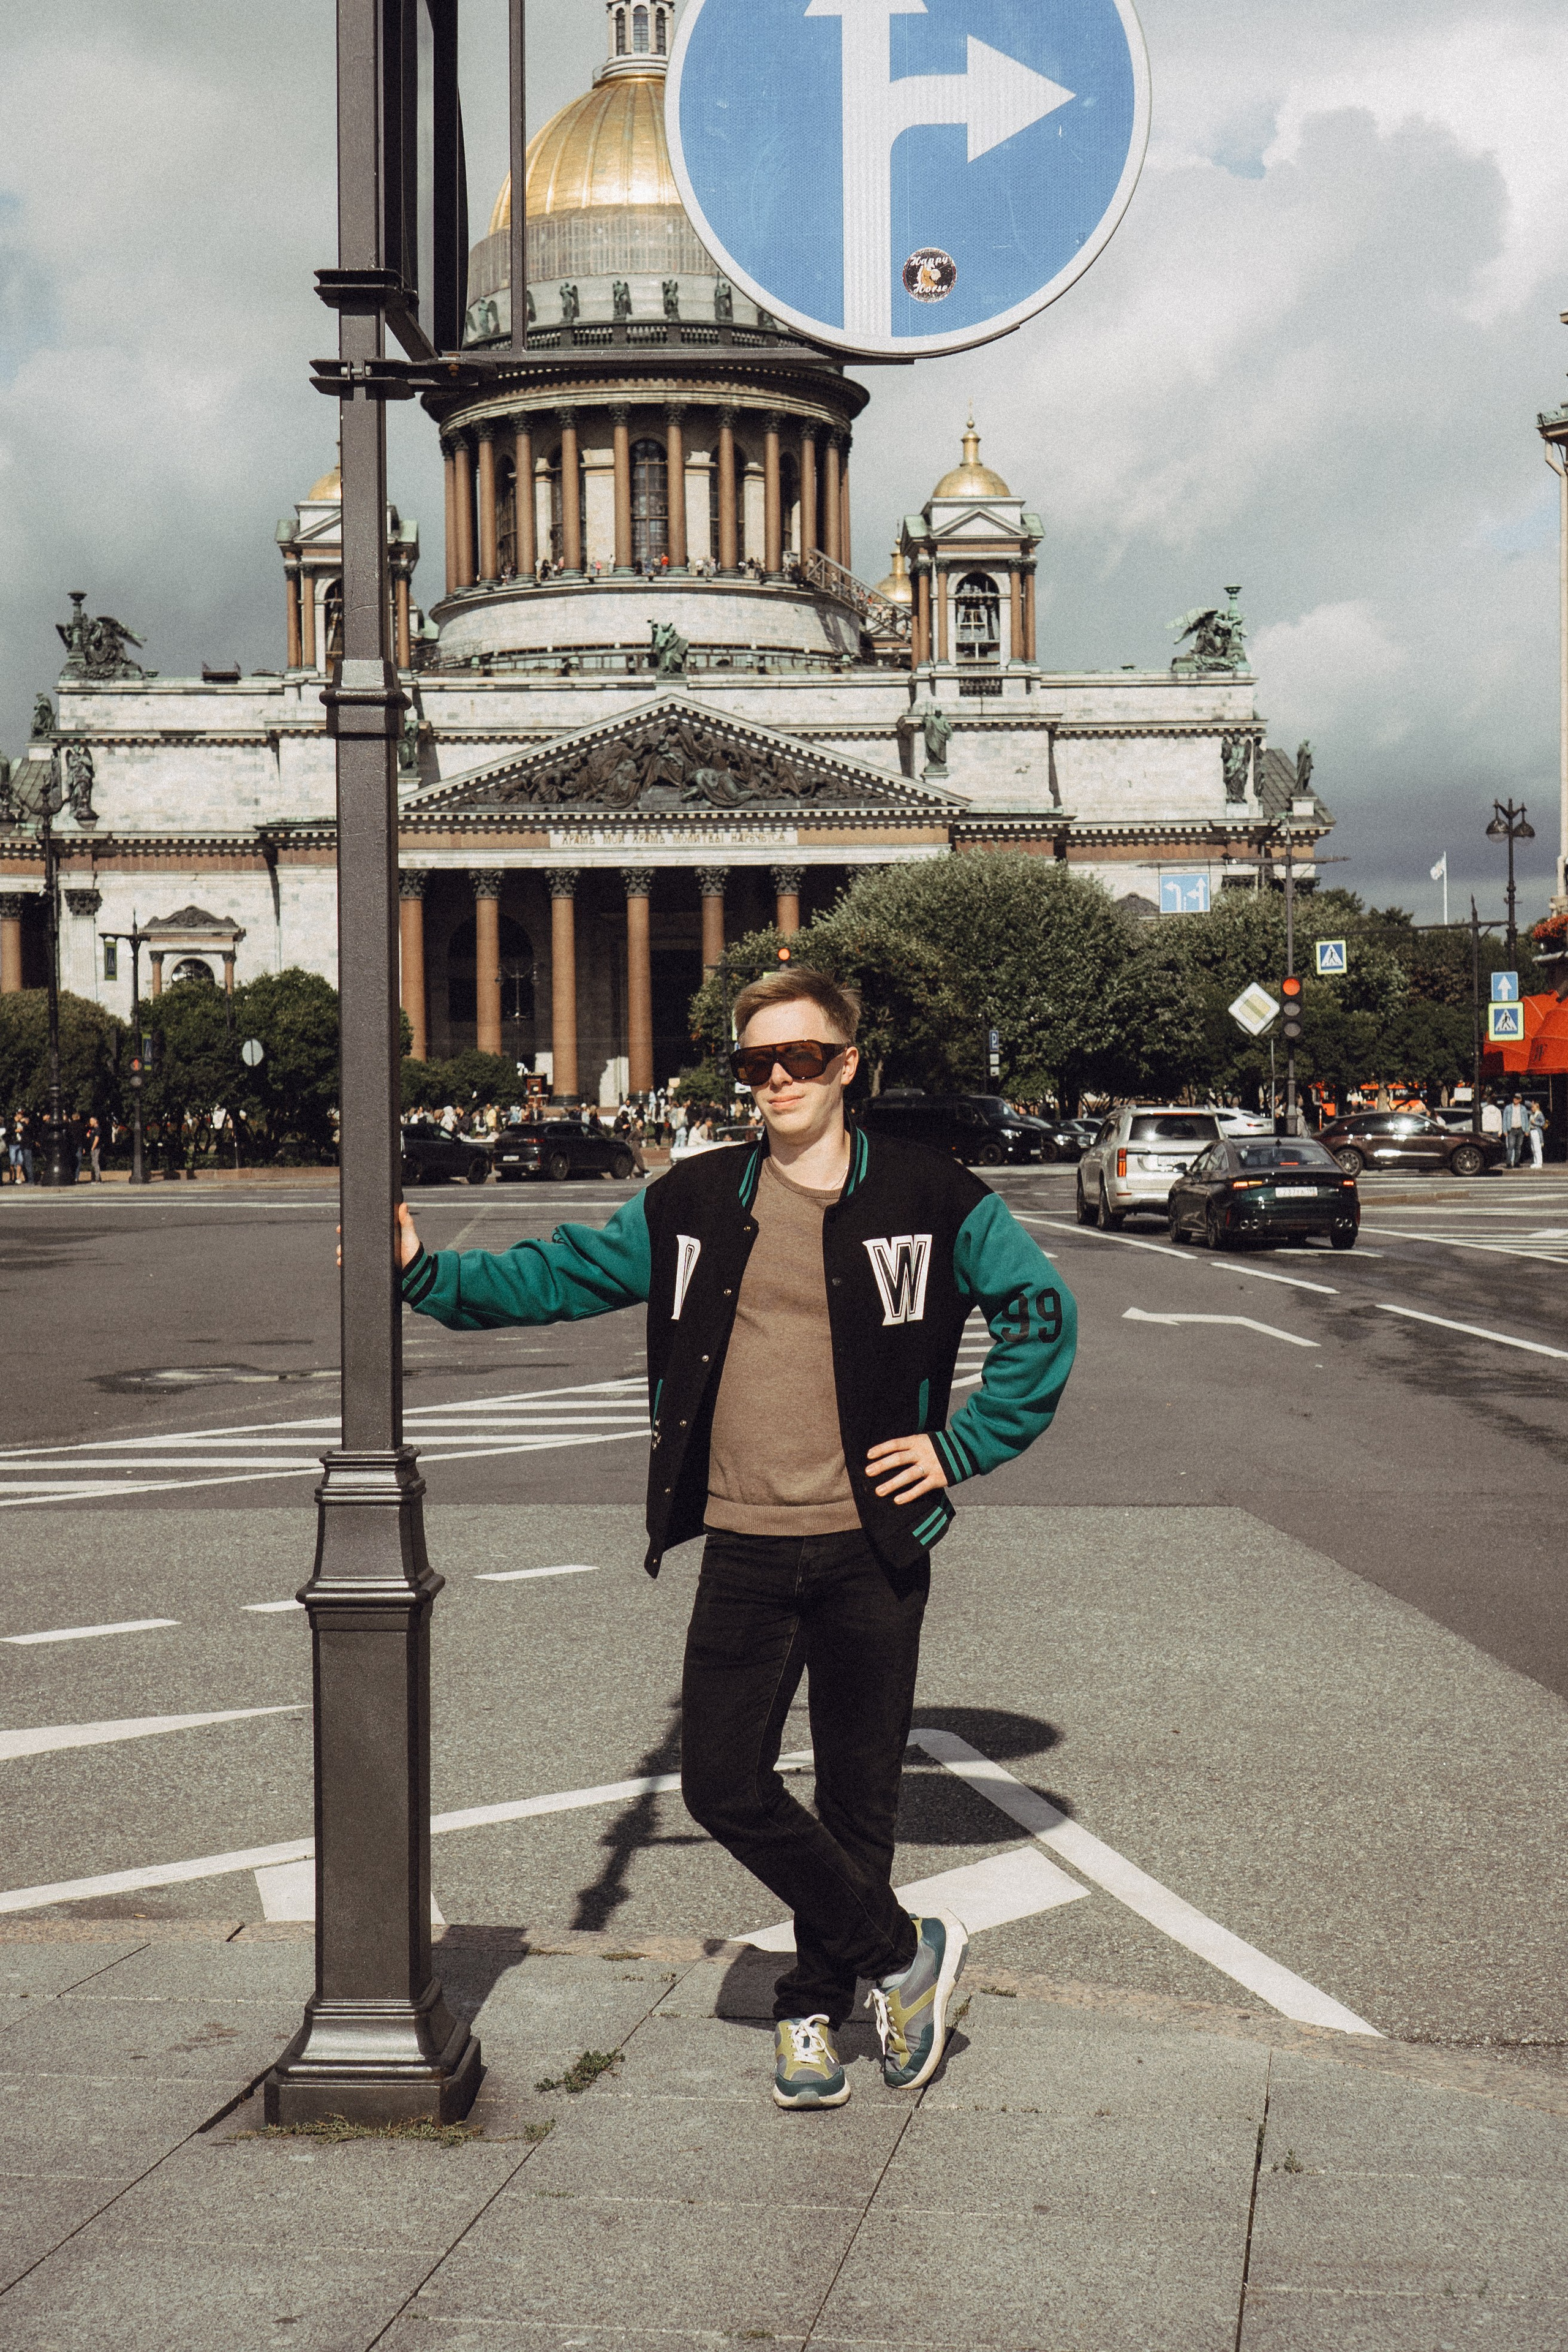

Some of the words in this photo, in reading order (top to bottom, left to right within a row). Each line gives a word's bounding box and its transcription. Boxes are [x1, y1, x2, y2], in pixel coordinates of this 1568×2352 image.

[910, 256, 948, 266] Happy
[913, 284, 948, 294] Horse
[862, 1234, 932, 1325] W
[1001, 1287, 1063, 1343] 99
